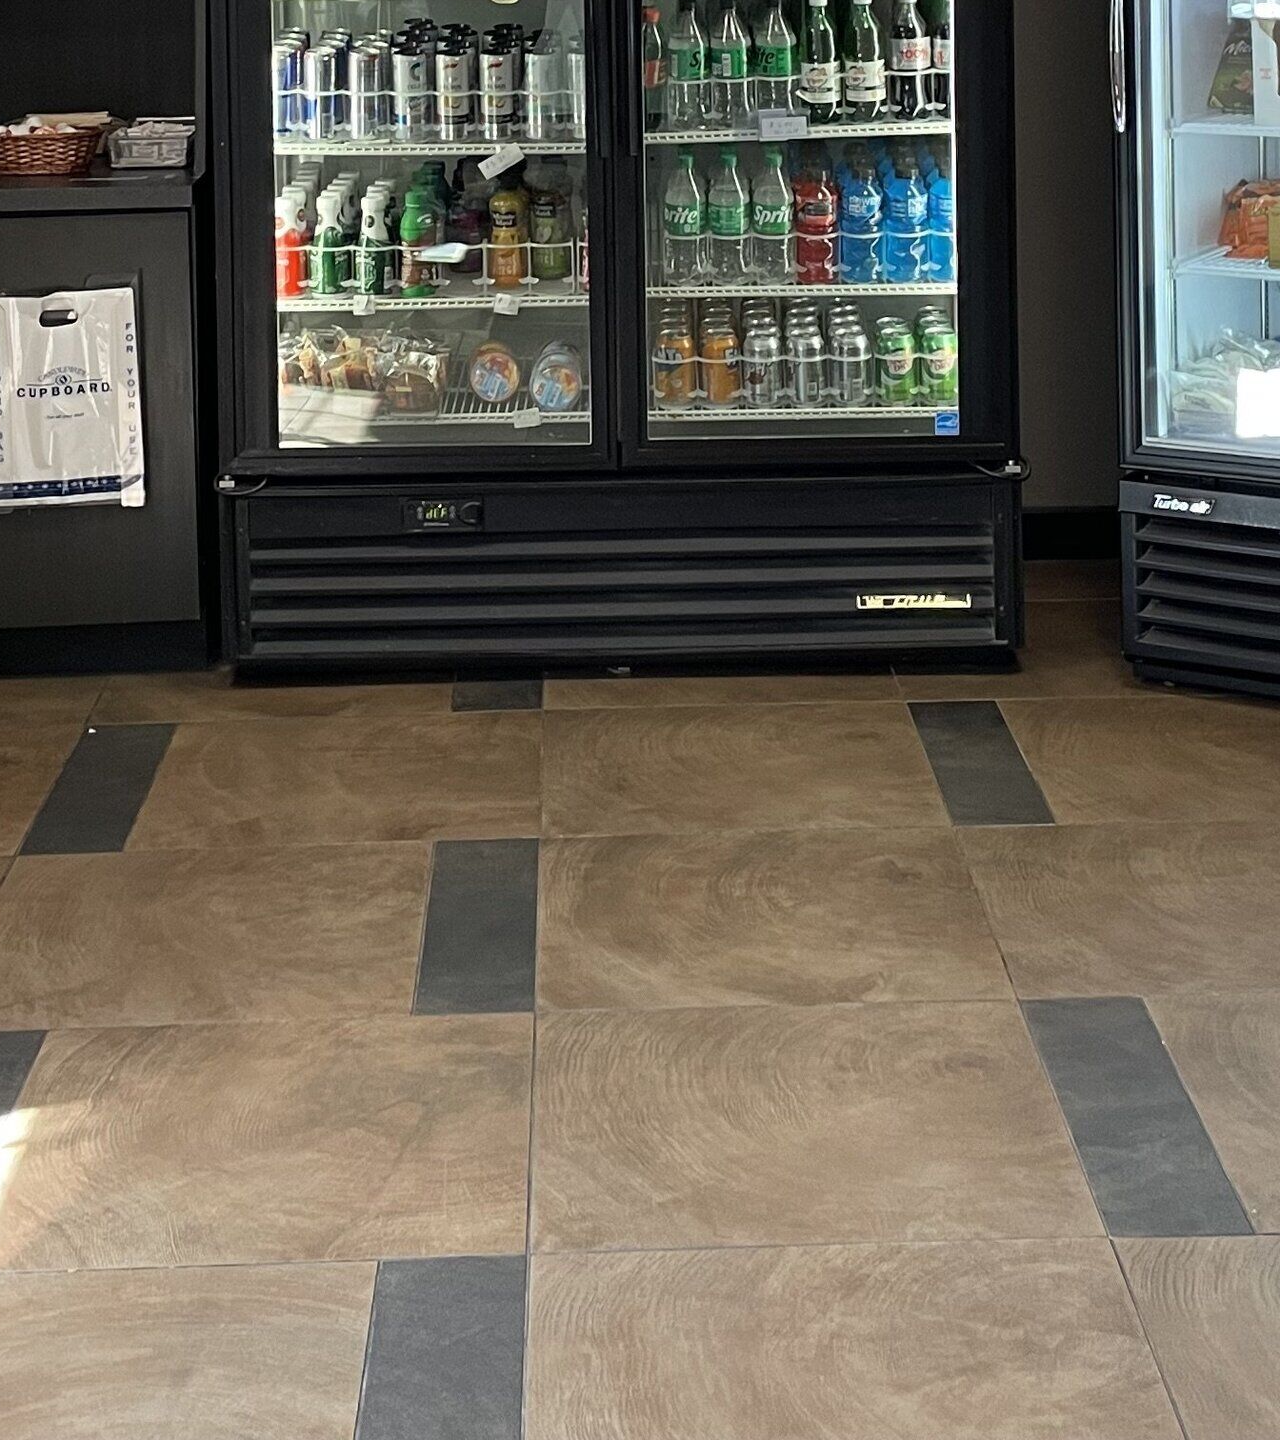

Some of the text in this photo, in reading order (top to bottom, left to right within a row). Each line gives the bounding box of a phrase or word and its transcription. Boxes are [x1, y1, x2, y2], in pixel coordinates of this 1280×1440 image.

[126, 323, 134, 352] FOR
[17, 382, 110, 398] CUPBOARD
[128, 368, 136, 409] YOUR
